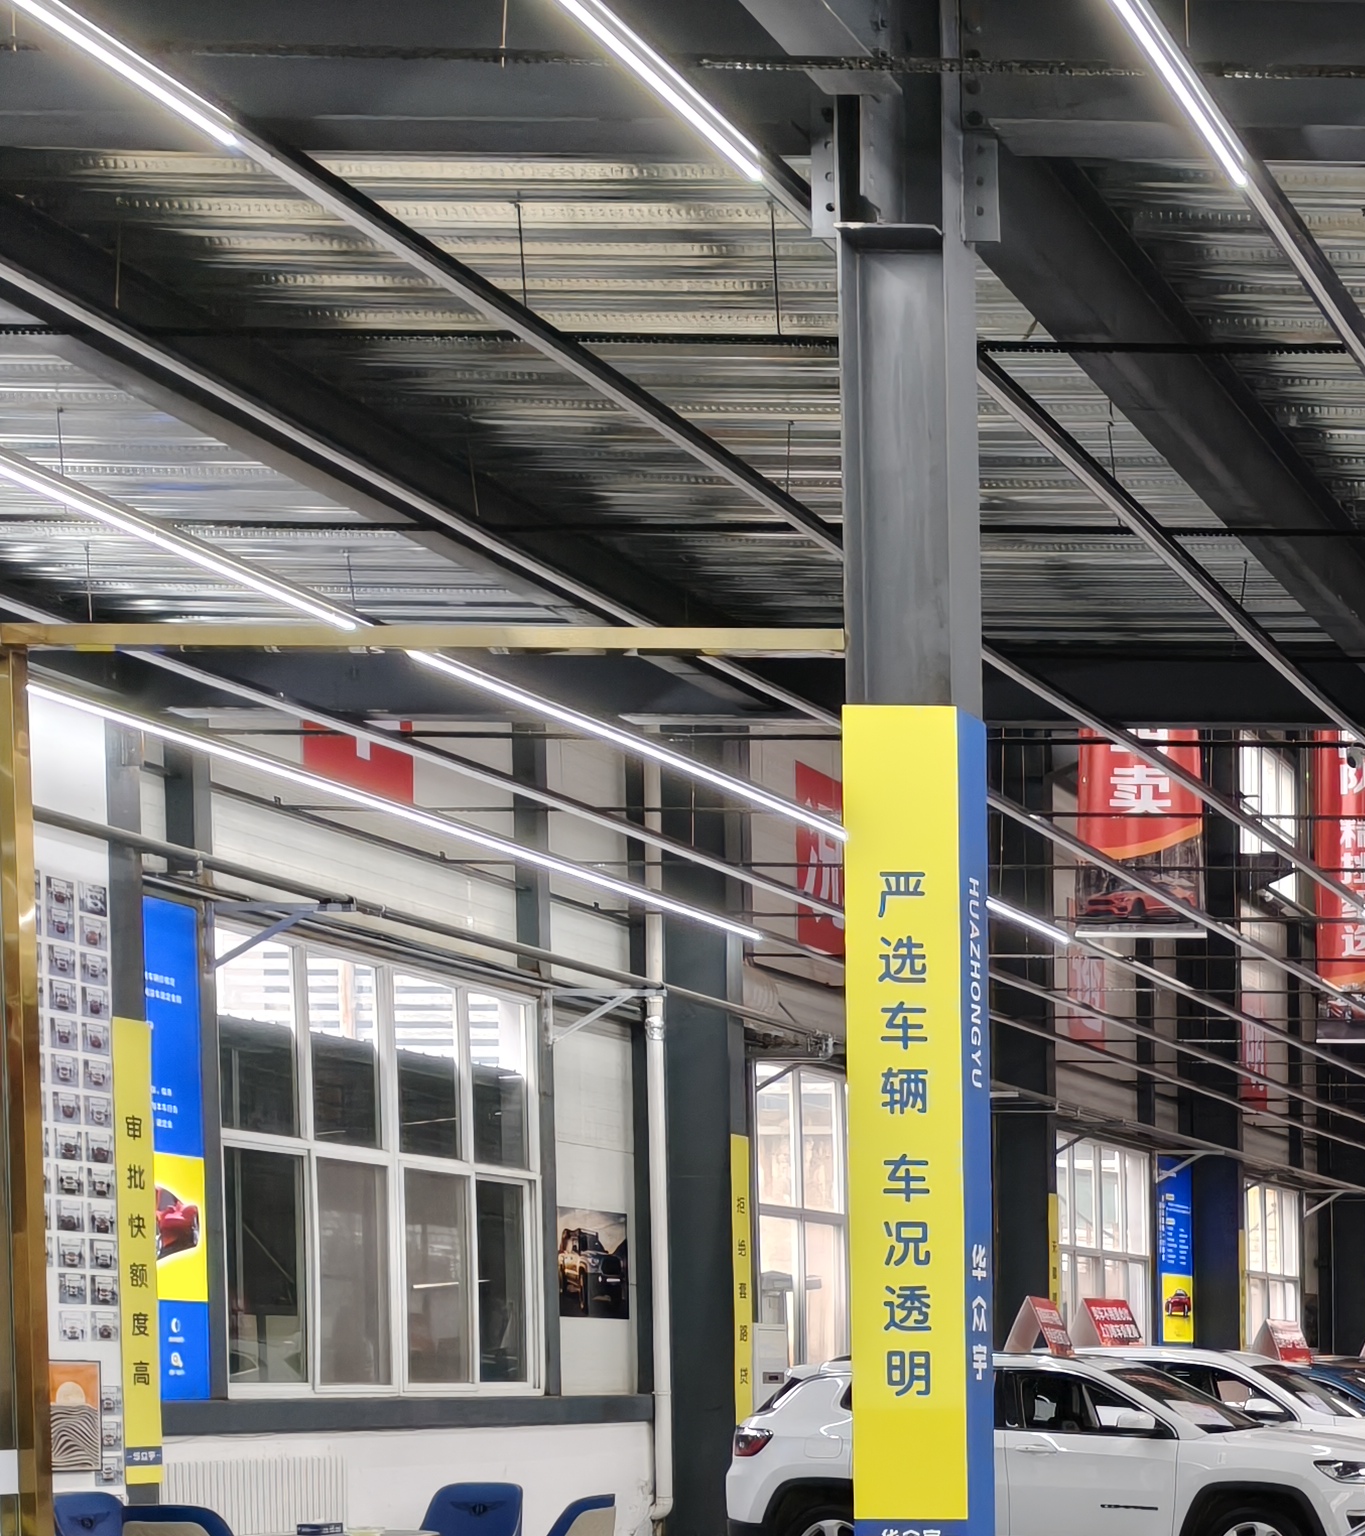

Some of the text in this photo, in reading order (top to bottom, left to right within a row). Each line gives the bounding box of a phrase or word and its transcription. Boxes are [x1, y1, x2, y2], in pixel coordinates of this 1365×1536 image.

[968, 877, 984, 1090] HUAZHONGYU
[124, 1114, 151, 1386] 审批快额度高
[878, 871, 932, 1397] 严选车辆 车况透明
[971, 1244, 988, 1381] 华众宇
